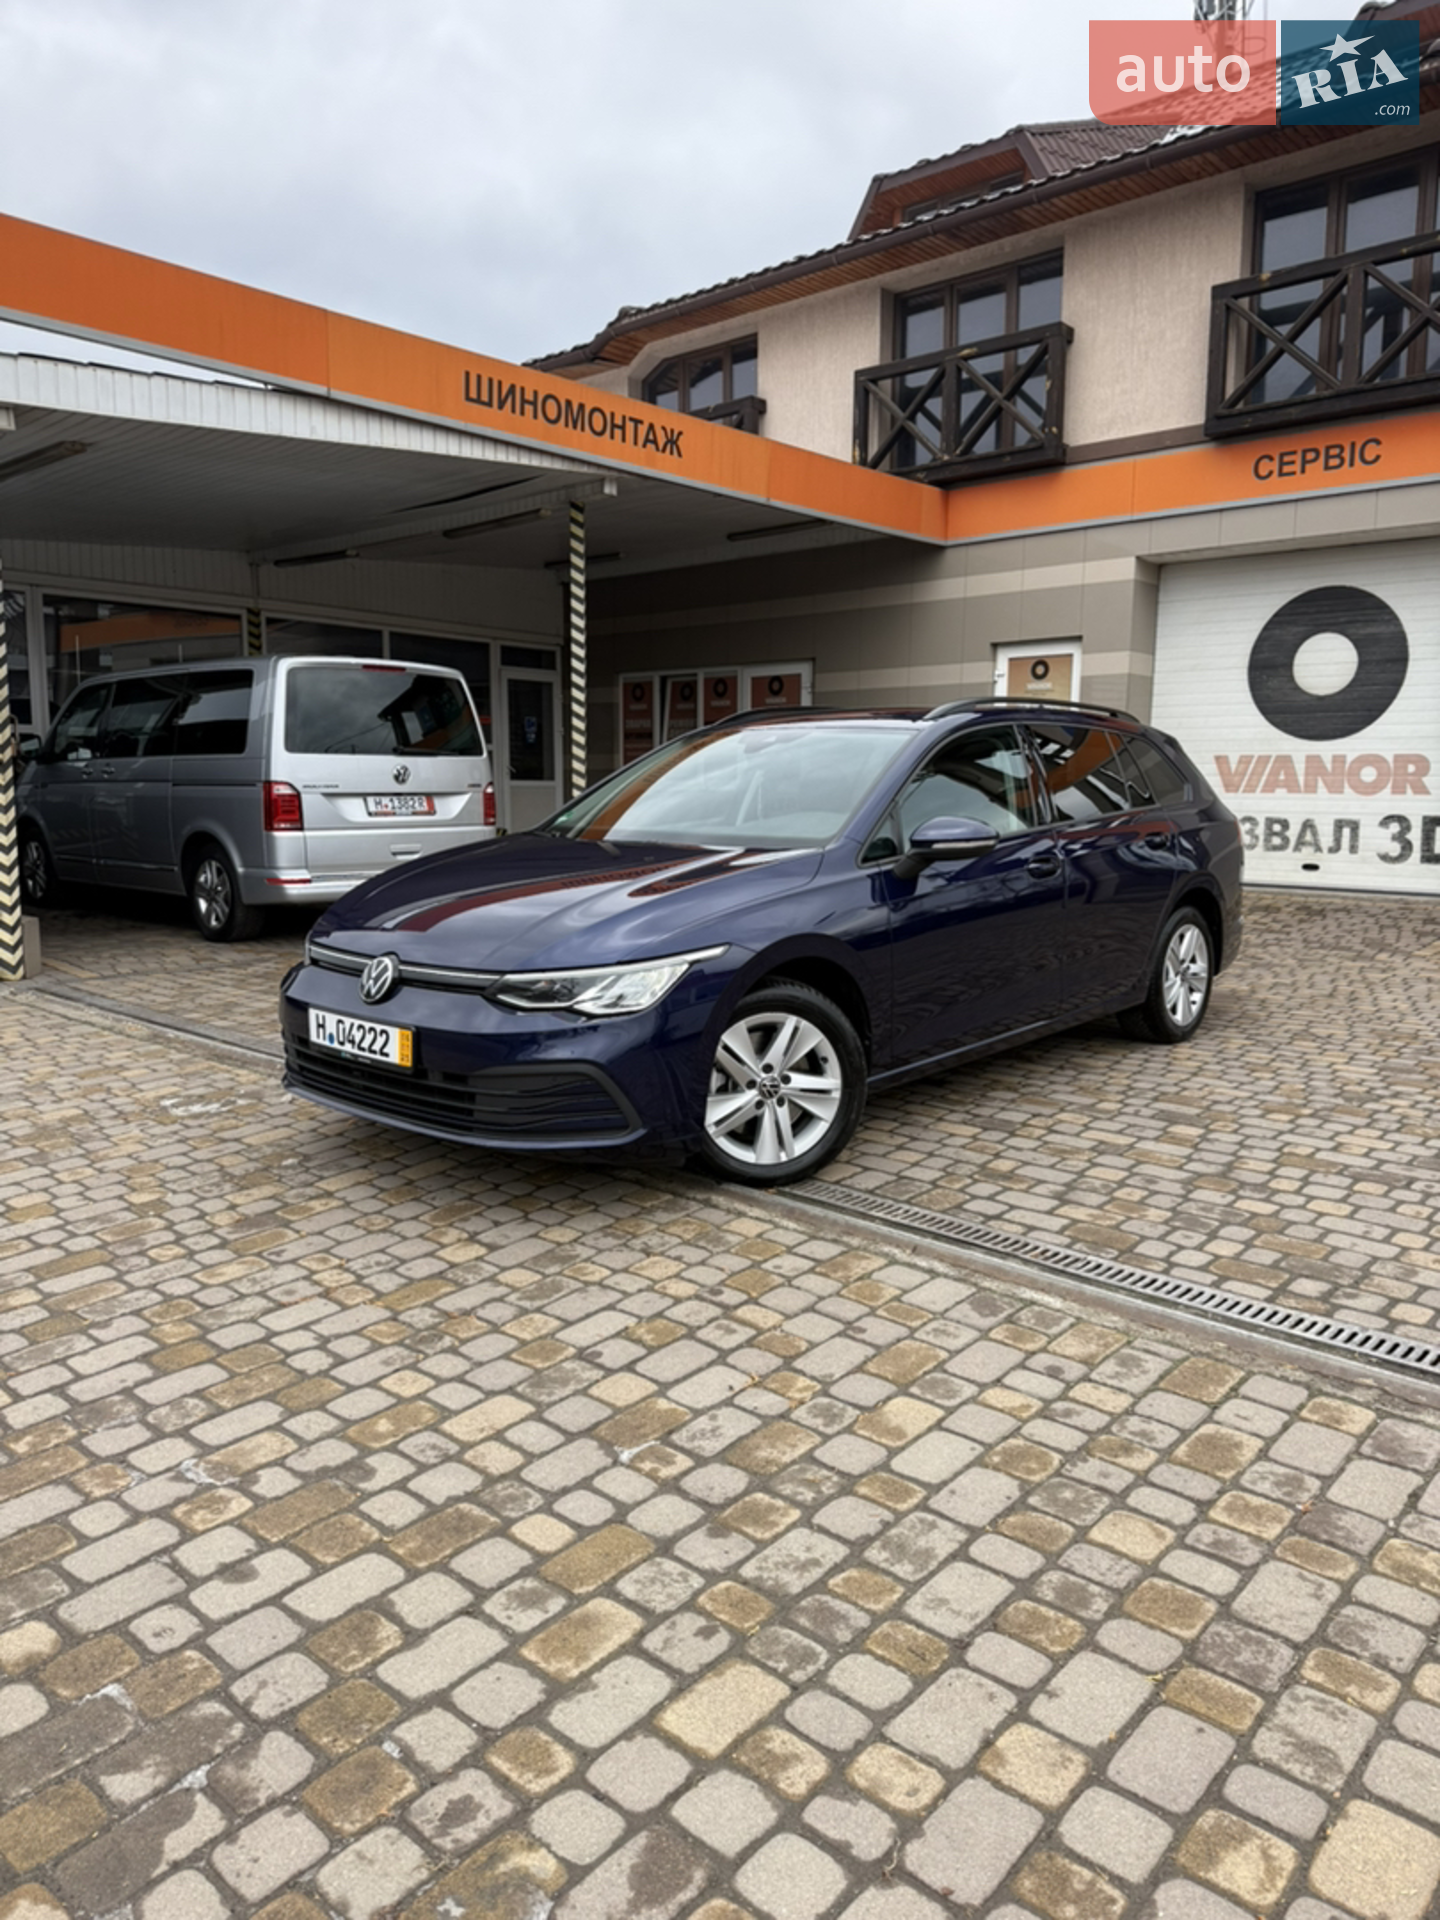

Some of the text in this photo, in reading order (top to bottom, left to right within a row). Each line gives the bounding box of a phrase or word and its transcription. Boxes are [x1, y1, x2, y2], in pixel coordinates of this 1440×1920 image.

[464, 370, 683, 458] ШИНОМОНТАЖ
[1253, 437, 1383, 481] СЕРВІС
[1214, 753, 1432, 797] VIANOR
